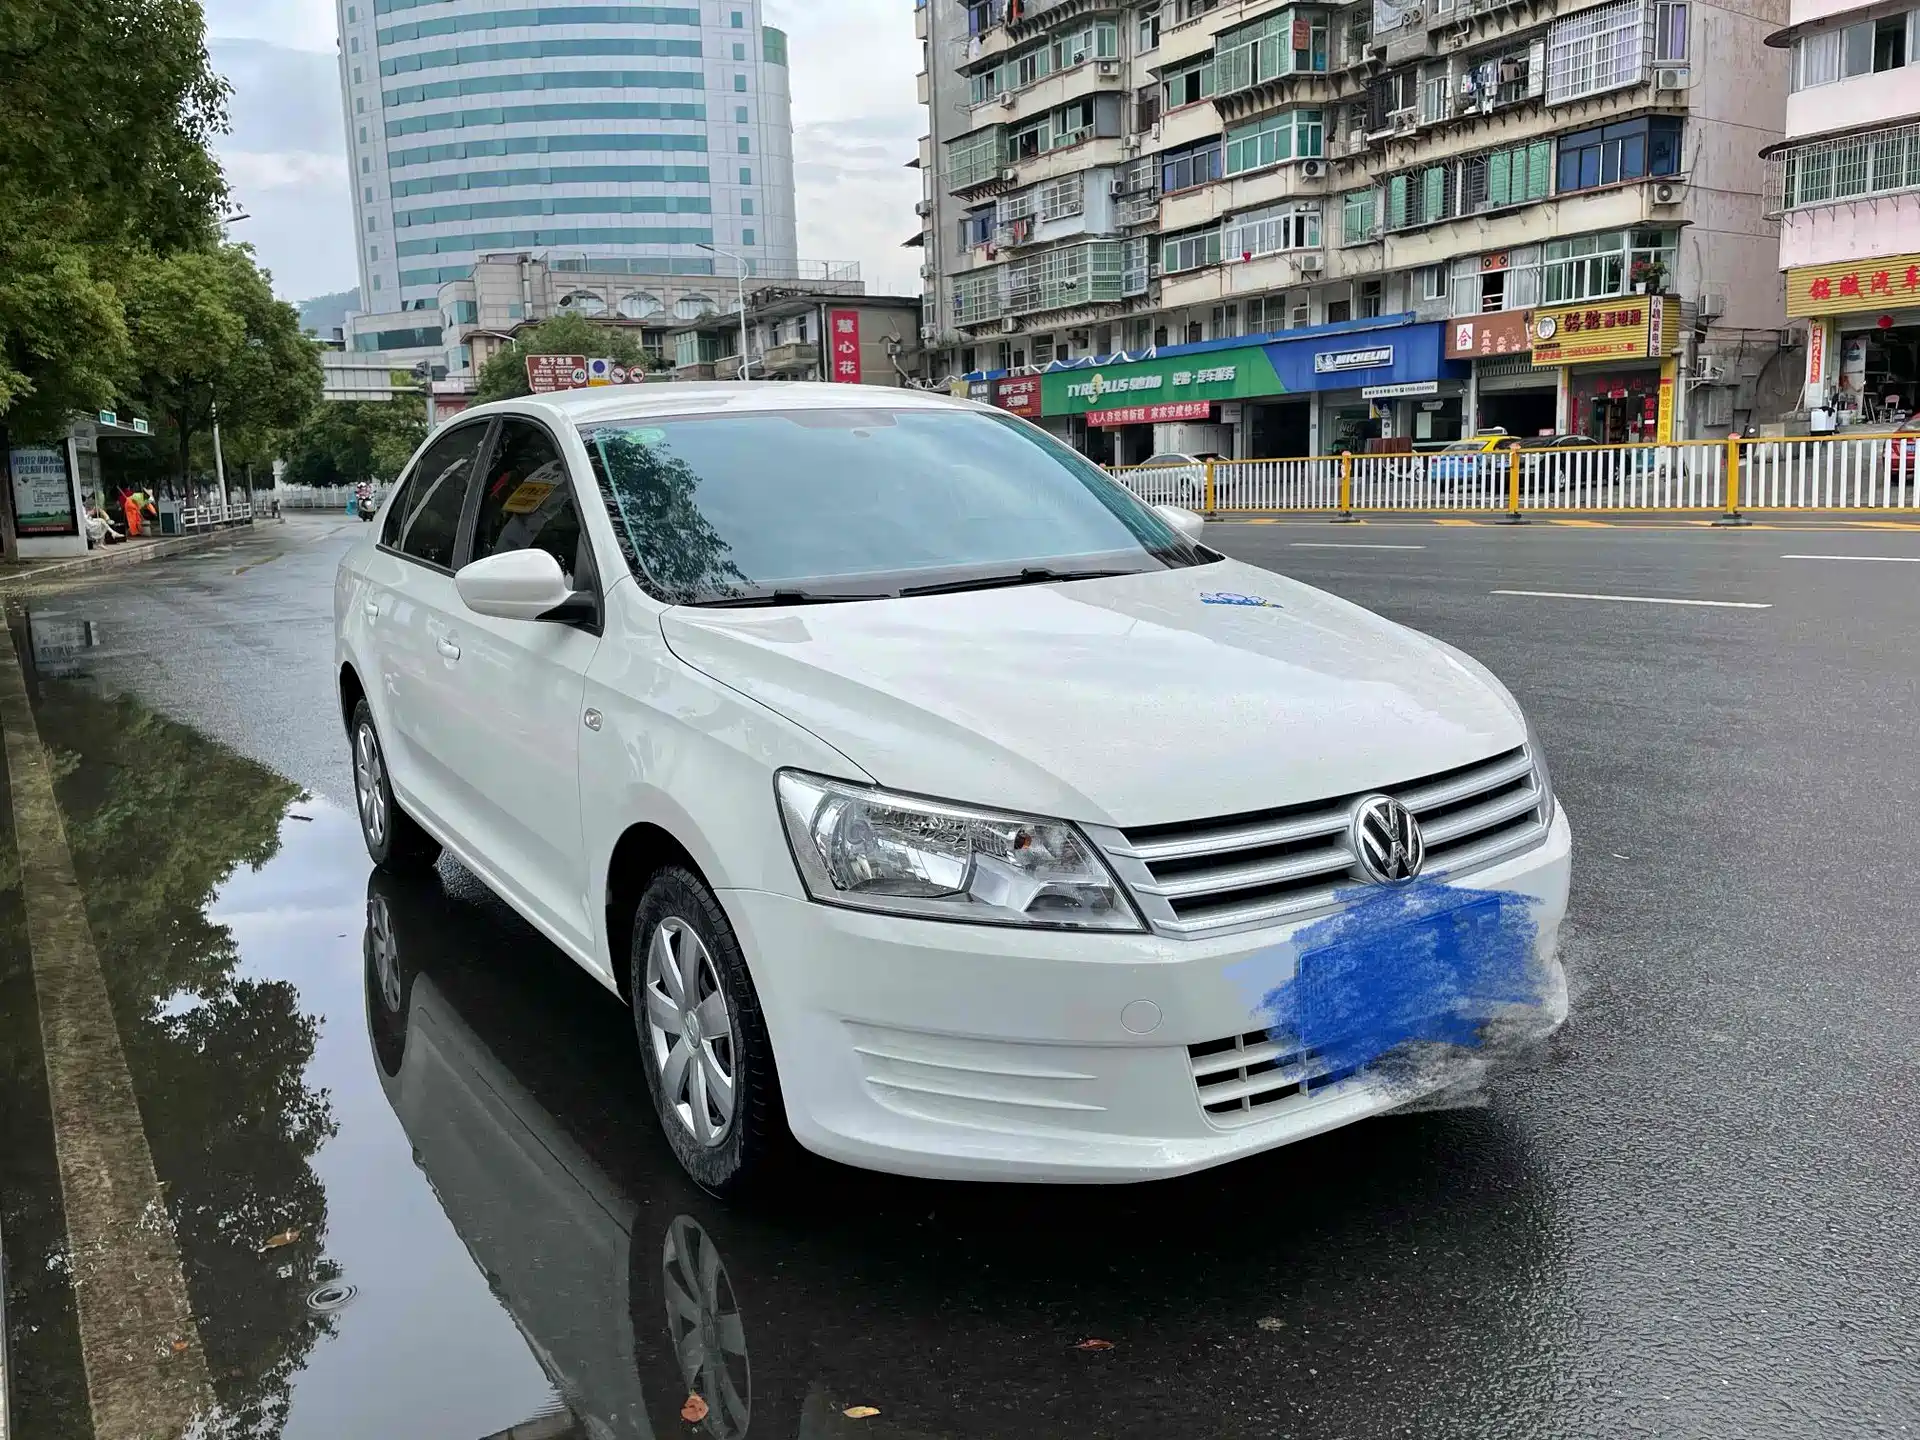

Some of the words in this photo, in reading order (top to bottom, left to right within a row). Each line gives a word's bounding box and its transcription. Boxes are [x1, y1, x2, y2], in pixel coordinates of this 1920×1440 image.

[836, 319, 857, 384] 慧心花
[1336, 349, 1391, 364] MICHELIN
[574, 371, 585, 380] 40
